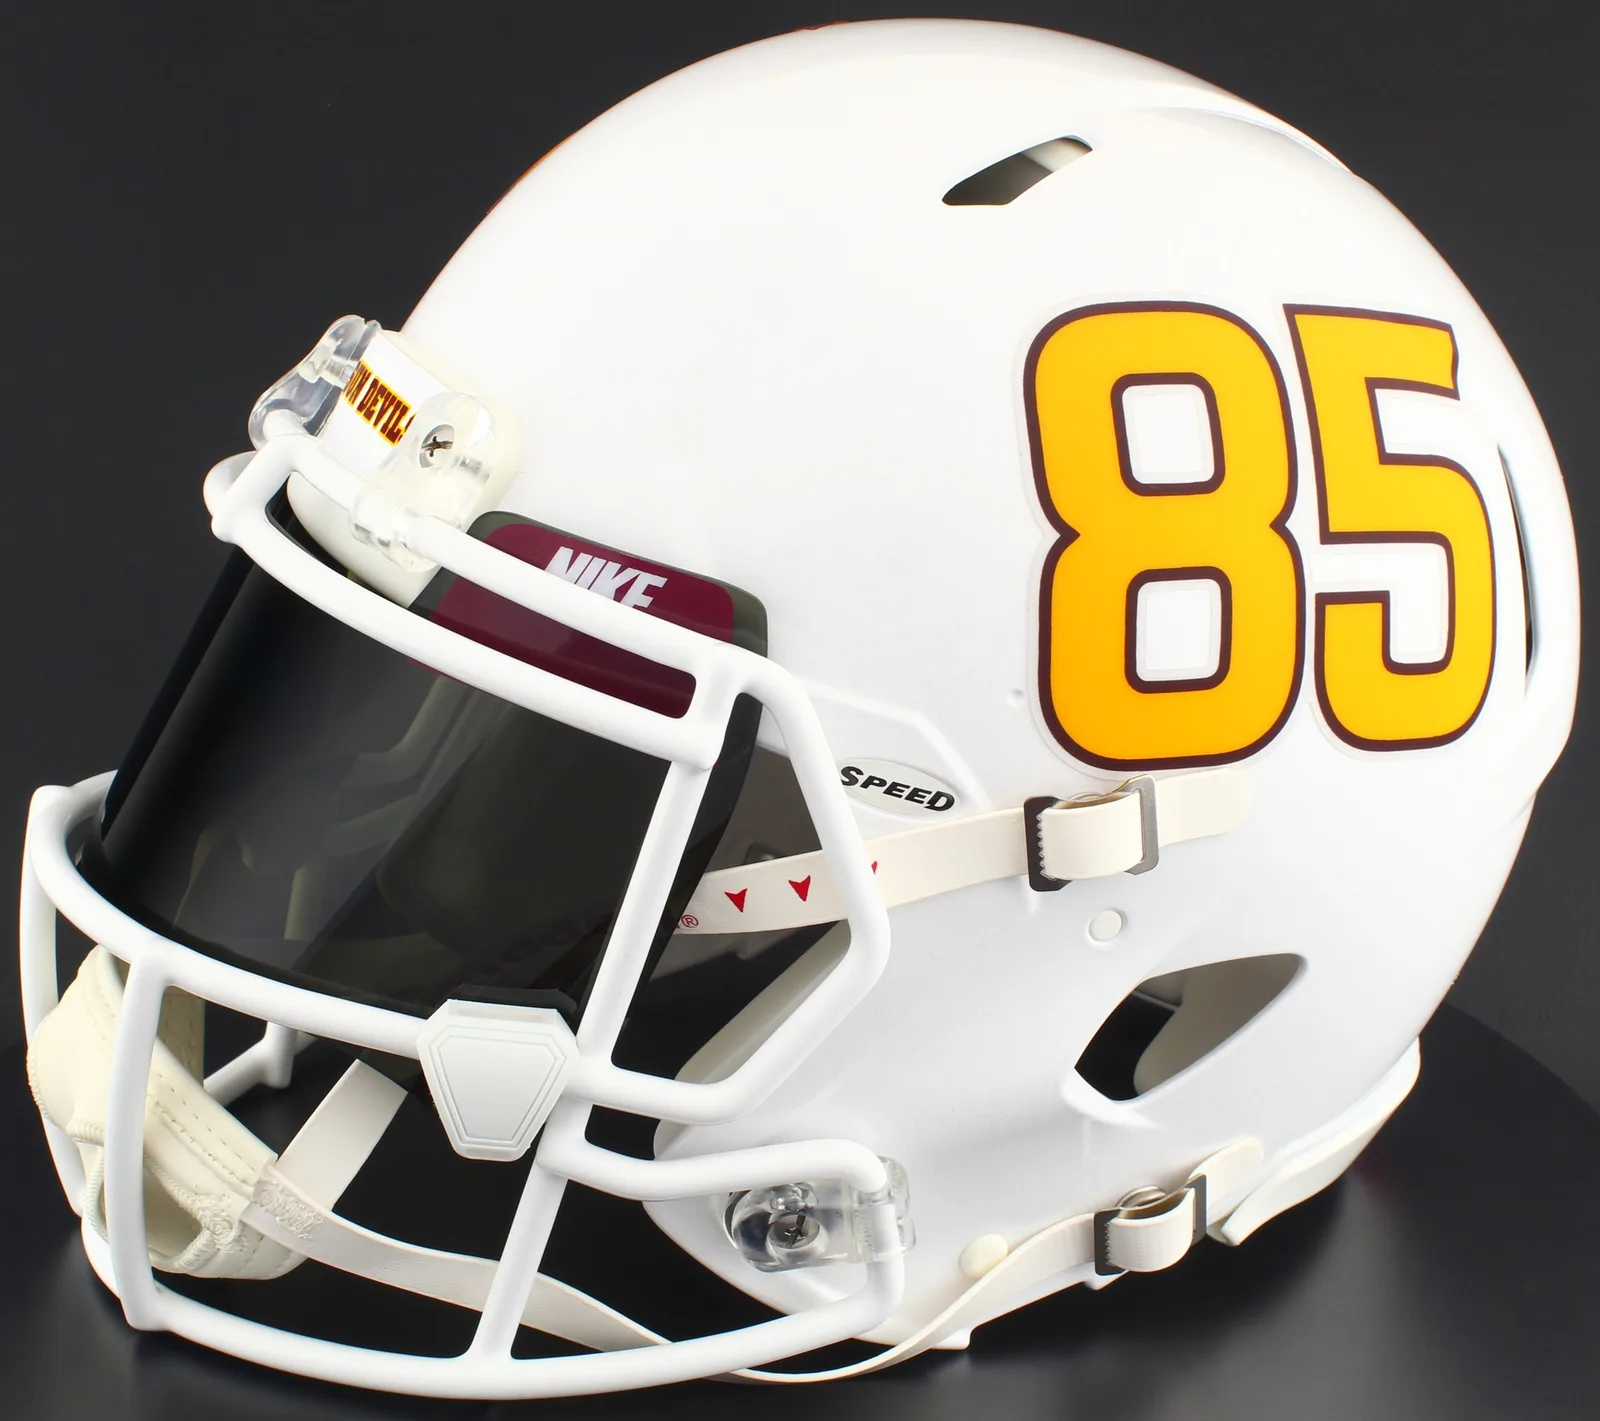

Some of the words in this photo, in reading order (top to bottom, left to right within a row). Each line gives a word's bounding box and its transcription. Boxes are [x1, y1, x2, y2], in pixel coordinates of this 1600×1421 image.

[355, 374, 418, 447] DEVIL
[1023, 300, 1497, 772] 85
[544, 546, 669, 609] NIKE
[840, 766, 955, 812] SPEED
